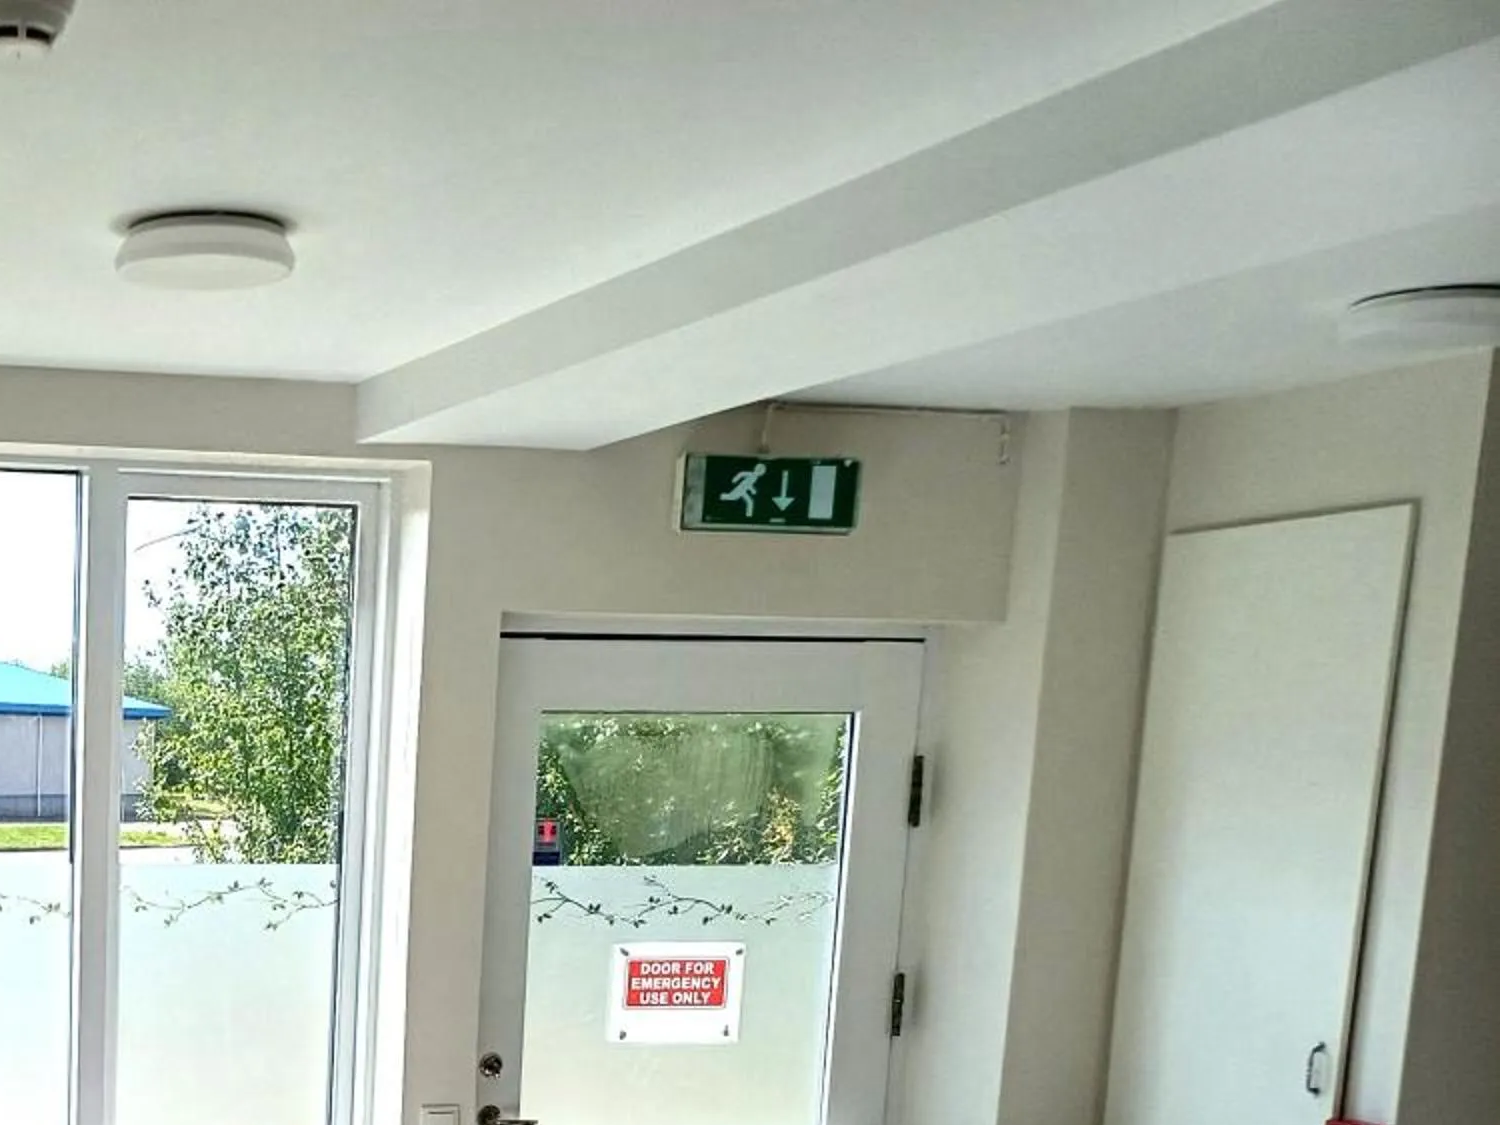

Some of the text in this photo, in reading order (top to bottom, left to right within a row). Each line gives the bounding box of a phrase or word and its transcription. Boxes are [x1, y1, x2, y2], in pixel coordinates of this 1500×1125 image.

[641, 962, 715, 975] DOOR FOR
[631, 977, 721, 990] EMERGENCY
[639, 991, 711, 1005] USE ONLY
